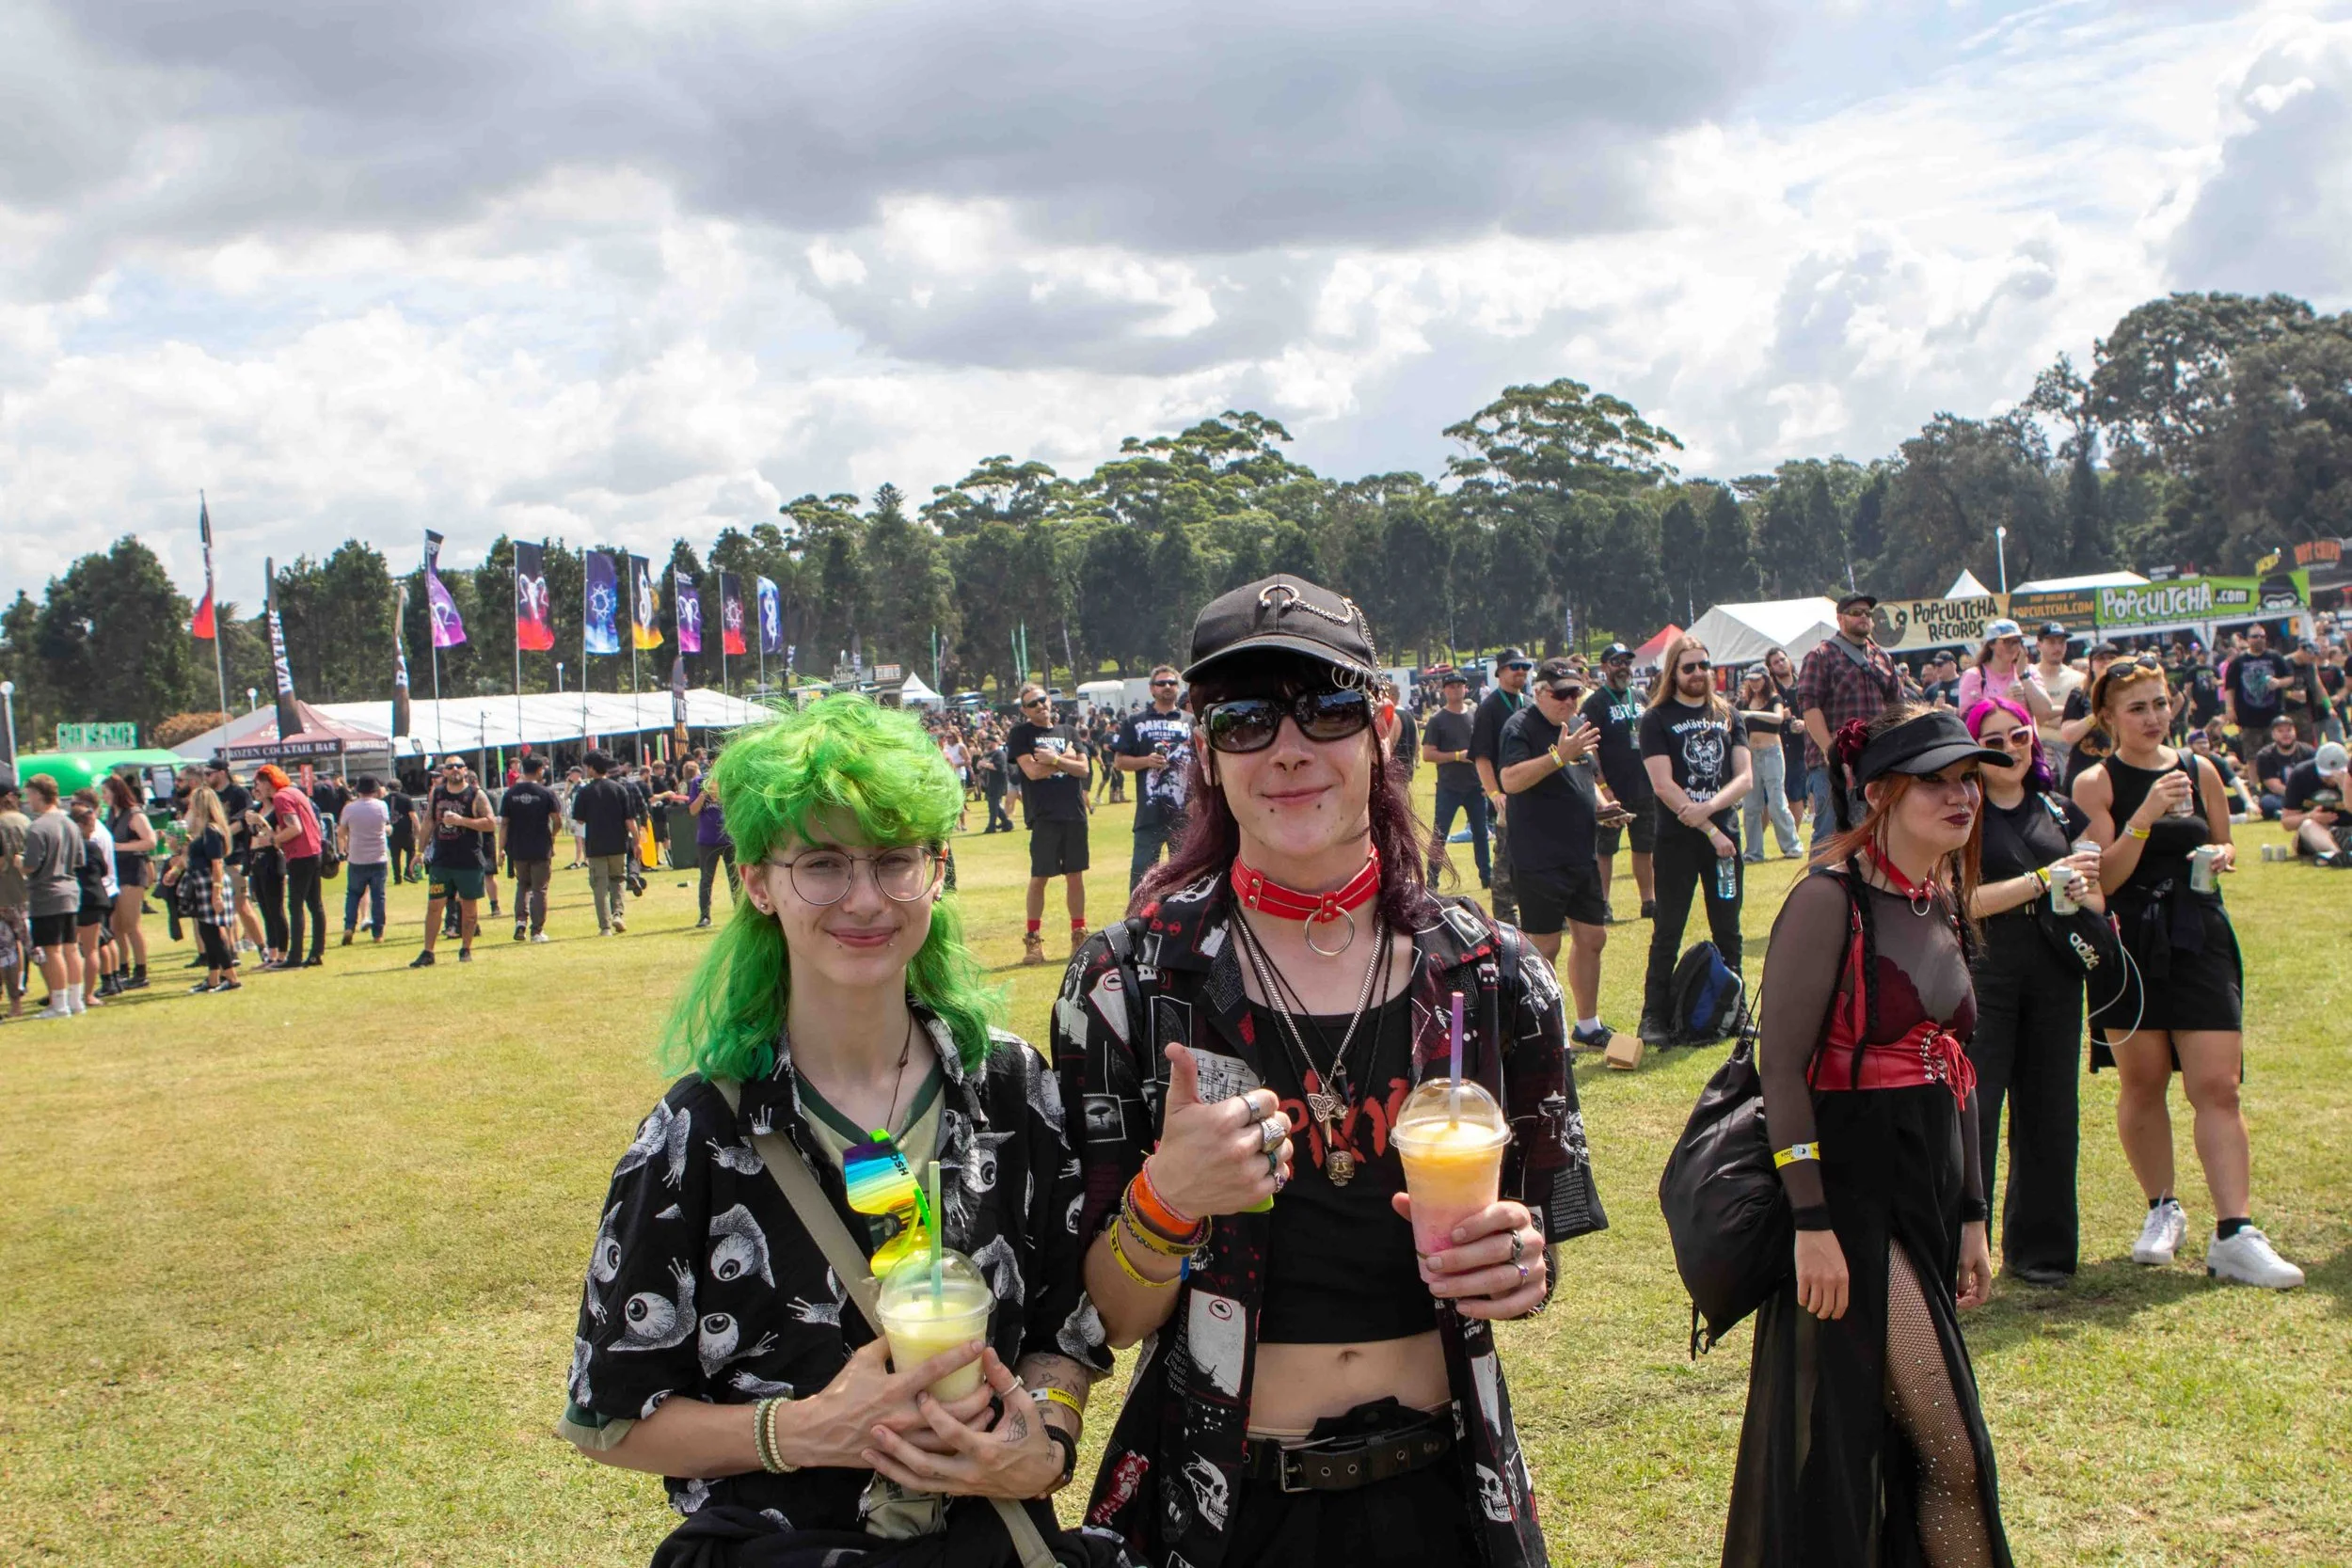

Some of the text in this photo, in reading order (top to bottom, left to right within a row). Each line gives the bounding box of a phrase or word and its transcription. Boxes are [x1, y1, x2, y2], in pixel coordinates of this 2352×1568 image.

[1913, 597, 1998, 624] POPCULTCHA
[2012, 601, 2094, 618] POPCULTCHA.COM
[2102, 581, 2247, 619] POPCULTCHA .com
[1928, 620, 1985, 641] RECORDS
[262, 742, 312, 757] COCKTAIL
[315, 741, 337, 752] BAR
[2070, 932, 2100, 970] adida
